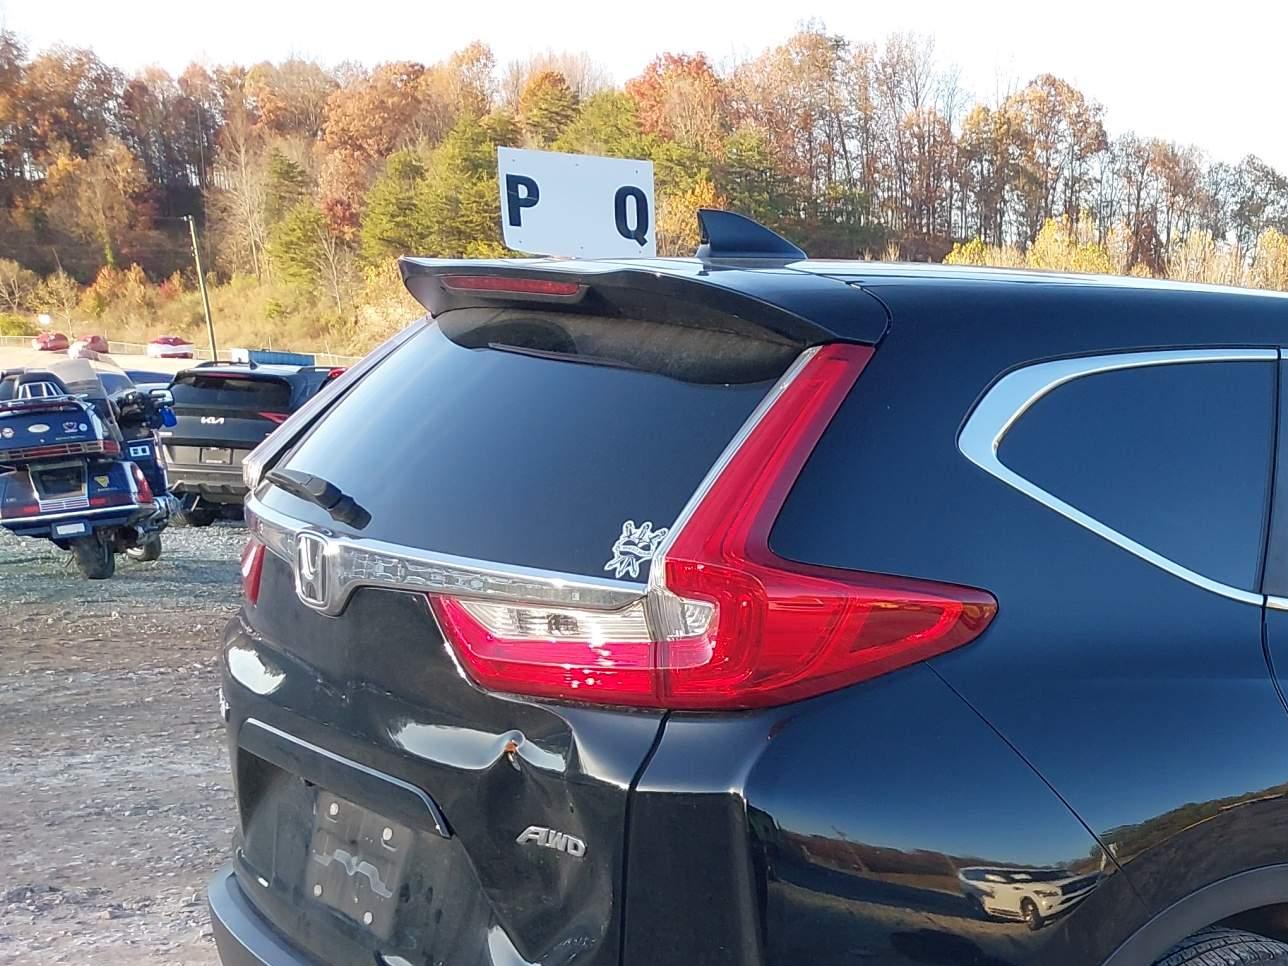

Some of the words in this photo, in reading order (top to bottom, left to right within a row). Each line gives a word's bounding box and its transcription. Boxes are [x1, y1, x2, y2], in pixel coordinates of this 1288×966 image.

[506, 173, 540, 227] P
[614, 185, 649, 247] Q
[515, 825, 587, 858] AWD
